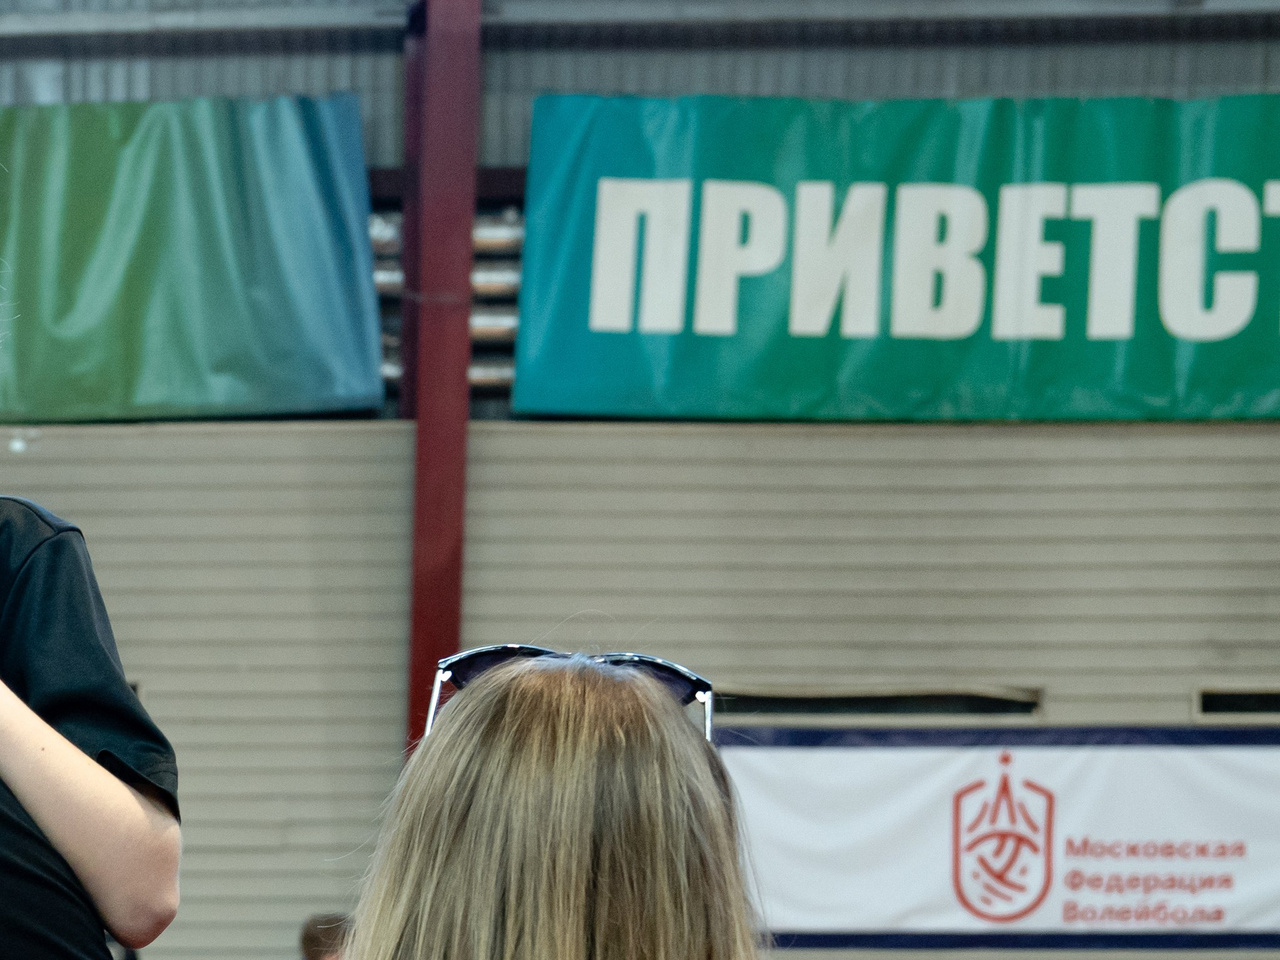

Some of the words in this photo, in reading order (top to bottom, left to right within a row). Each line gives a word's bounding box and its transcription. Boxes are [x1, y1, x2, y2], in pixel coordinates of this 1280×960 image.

[589, 177, 1280, 341] ПРИВЕТС
[1065, 837, 1246, 857] Московская
[1064, 869, 1233, 895] Федерация
[1062, 900, 1225, 923] Волейбола
